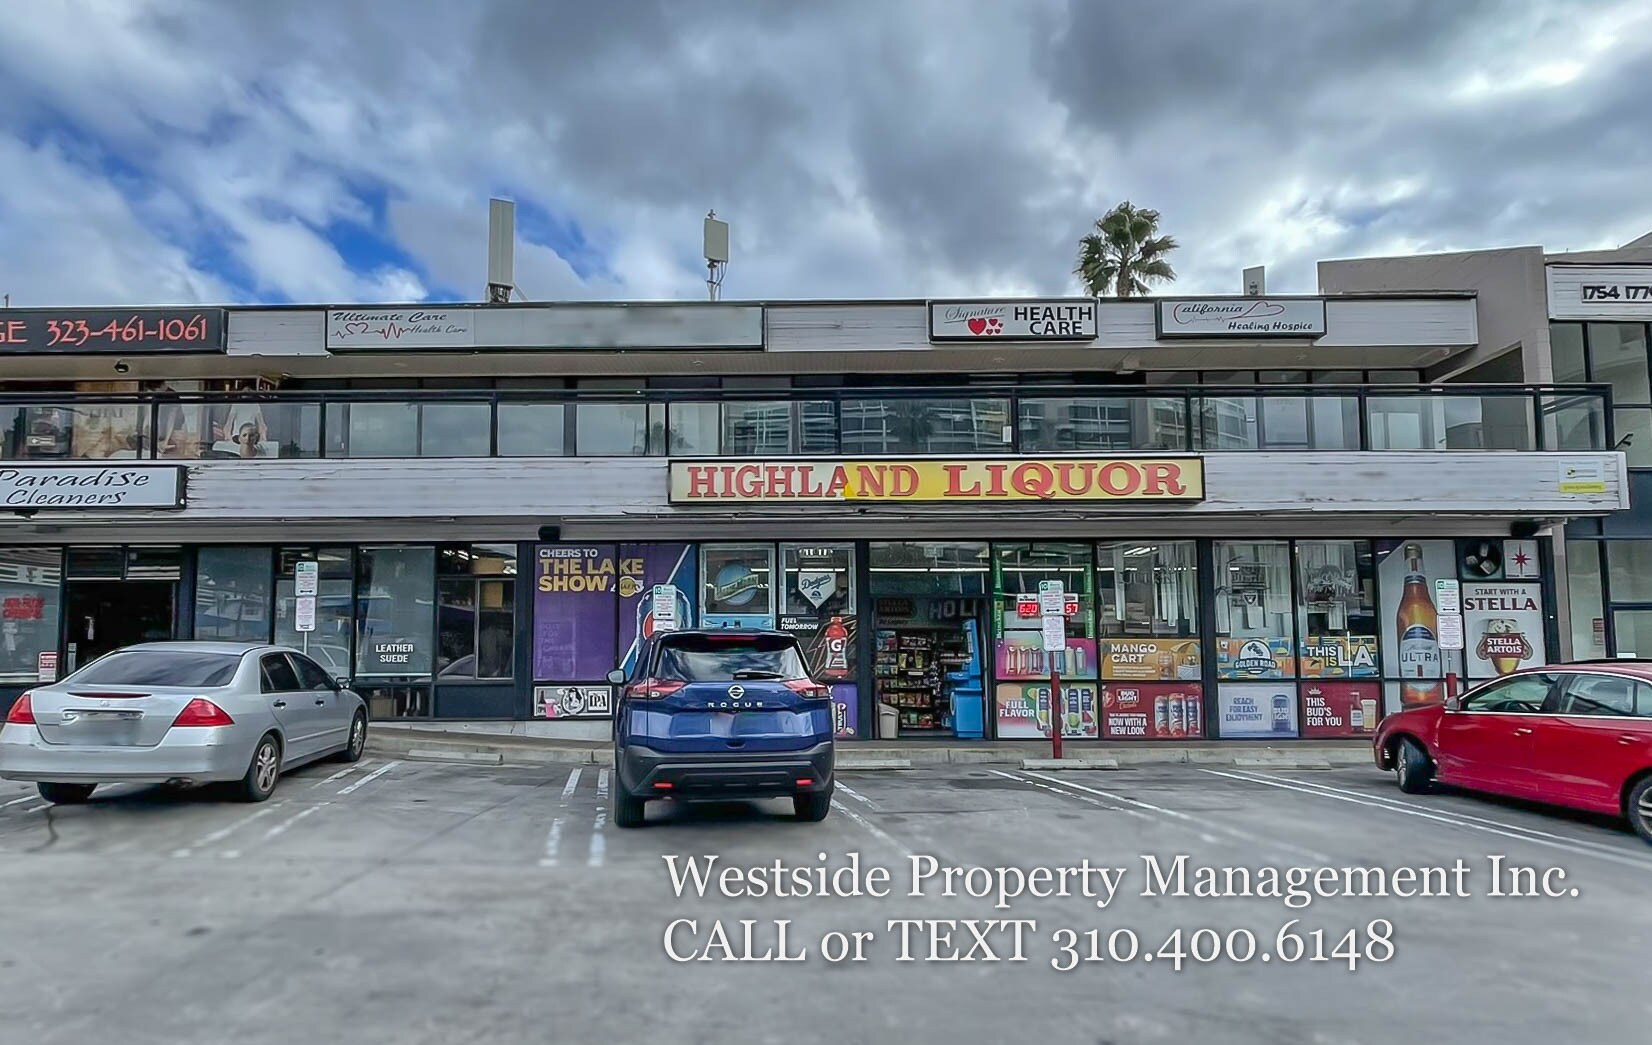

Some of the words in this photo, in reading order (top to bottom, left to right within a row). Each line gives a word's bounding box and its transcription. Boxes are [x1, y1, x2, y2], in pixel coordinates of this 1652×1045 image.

[1583, 286, 1620, 299] 1754
[1625, 286, 1652, 299] 177
[333, 312, 402, 322] Ultimate
[408, 312, 447, 323] Care
[945, 306, 1006, 321] Signature
[1014, 306, 1092, 320] HEALTH
[1173, 302, 1243, 324] California
[46, 314, 207, 346] 323-461-1061
[409, 324, 441, 333] Health
[445, 324, 467, 333] Care
[1029, 321, 1083, 335] CARE
[1228, 322, 1270, 331] Healing
[1272, 322, 1313, 331] Hospice
[0, 469, 150, 487] Paradise
[687, 465, 920, 498] HIGHLAND
[944, 462, 1187, 498] LIQUOR
[6, 489, 127, 505] Cleaners
[540, 549, 581, 558] CHEERS
[583, 549, 598, 558] TO
[540, 559, 582, 575] THE
[587, 559, 644, 575] LAKE
[539, 576, 608, 592] SHOW
[801, 574, 831, 590] Dodgers
[1464, 598, 1538, 611] STELLA
[831, 639, 841, 651] G
[1487, 637, 1522, 645] STELLA
[375, 644, 413, 653] LEATHER
[1111, 644, 1157, 653] MANGO
[1487, 645, 1522, 653] ARTOIS
[380, 654, 408, 663] SUEDE
[1111, 653, 1145, 663] CART
[1307, 646, 1337, 657] THIS
[1326, 657, 1337, 666] IS
[1338, 646, 1374, 667] LA
[1401, 652, 1439, 662] ULTRA
[1235, 660, 1258, 668] GOLDEN
[1259, 659, 1276, 668] ROAD
[1005, 701, 1028, 709] FULL
[1306, 698, 1326, 707] THIS
[1000, 709, 1035, 718] FLAVOR
[1229, 705, 1242, 713] FOR
[1243, 705, 1258, 713] EASY
[1306, 707, 1332, 717] BUD'S
[1109, 718, 1124, 726] NOW
[1125, 718, 1141, 726] WITH
[1142, 718, 1147, 726] A
[1226, 713, 1263, 722] ENJOYMENT
[1306, 717, 1324, 727] FOR
[1325, 717, 1342, 727] YOU
[1111, 726, 1126, 735] NEW
[1127, 726, 1145, 735] LOOK
